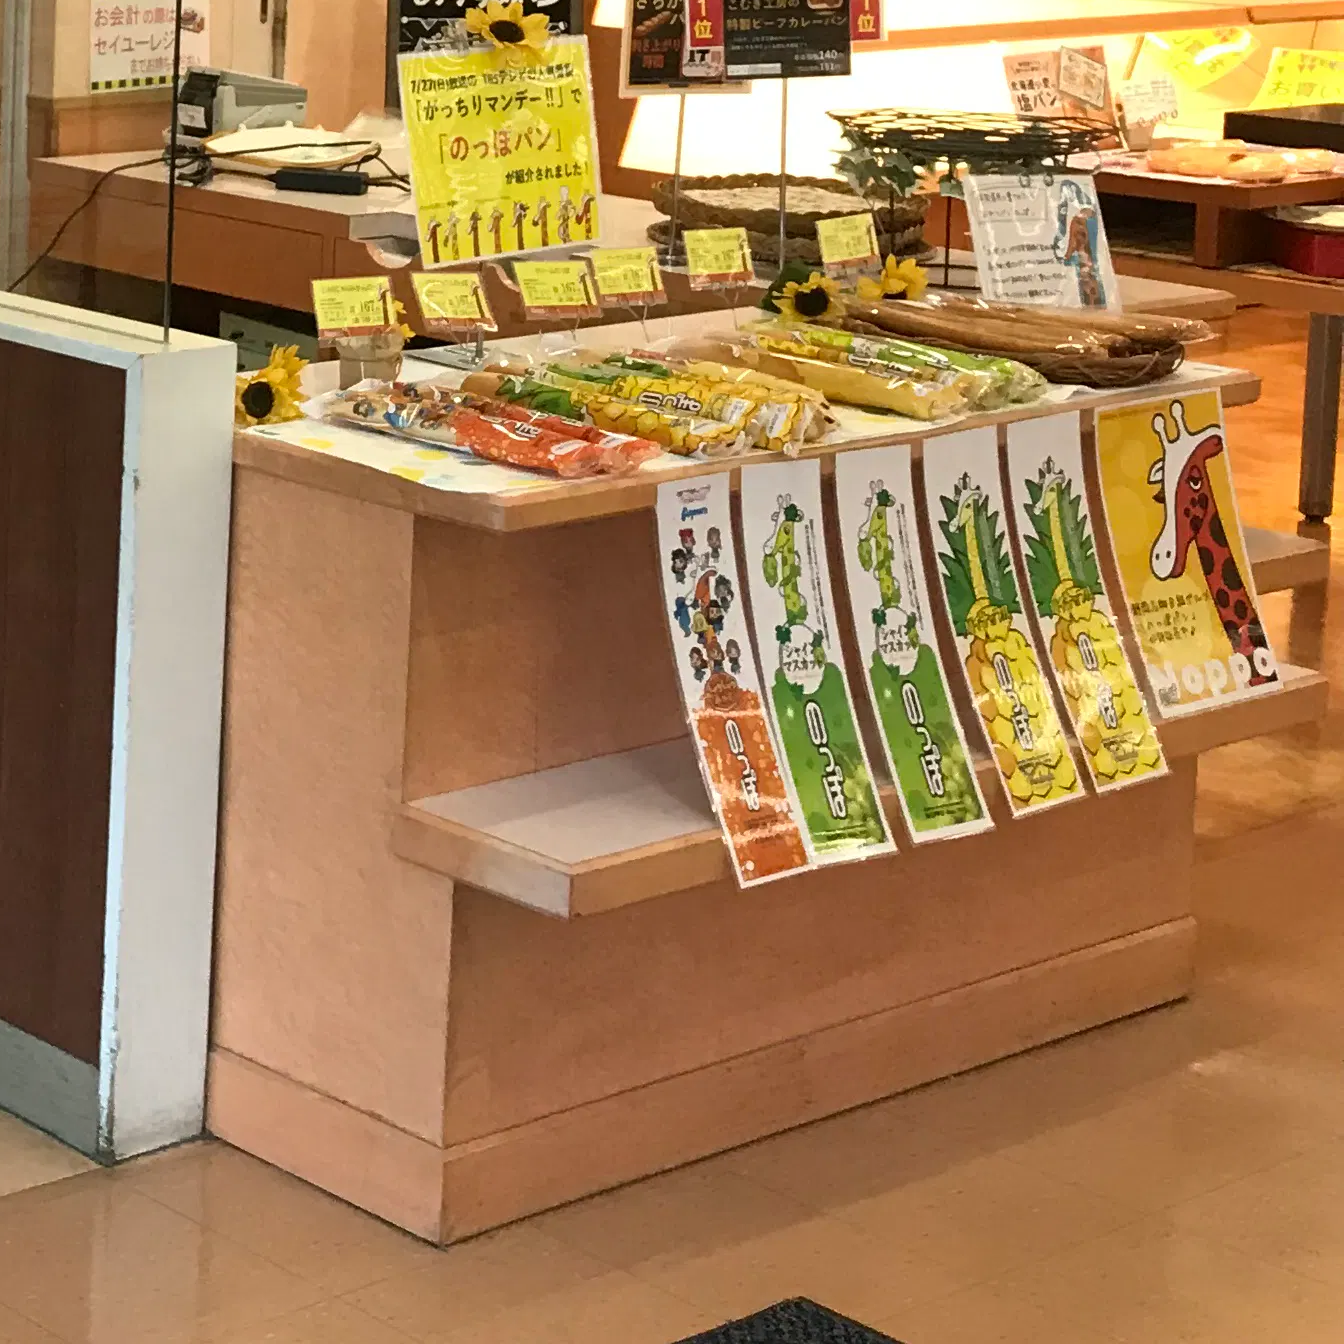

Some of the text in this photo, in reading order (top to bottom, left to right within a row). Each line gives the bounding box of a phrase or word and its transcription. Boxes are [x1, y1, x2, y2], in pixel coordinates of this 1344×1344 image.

[638, 391, 702, 412] のっぽ
[1148, 646, 1278, 703] Noppo
[725, 720, 760, 811] のっぽ
[805, 700, 848, 820] のっぽ
[902, 680, 944, 797] のっぽ
